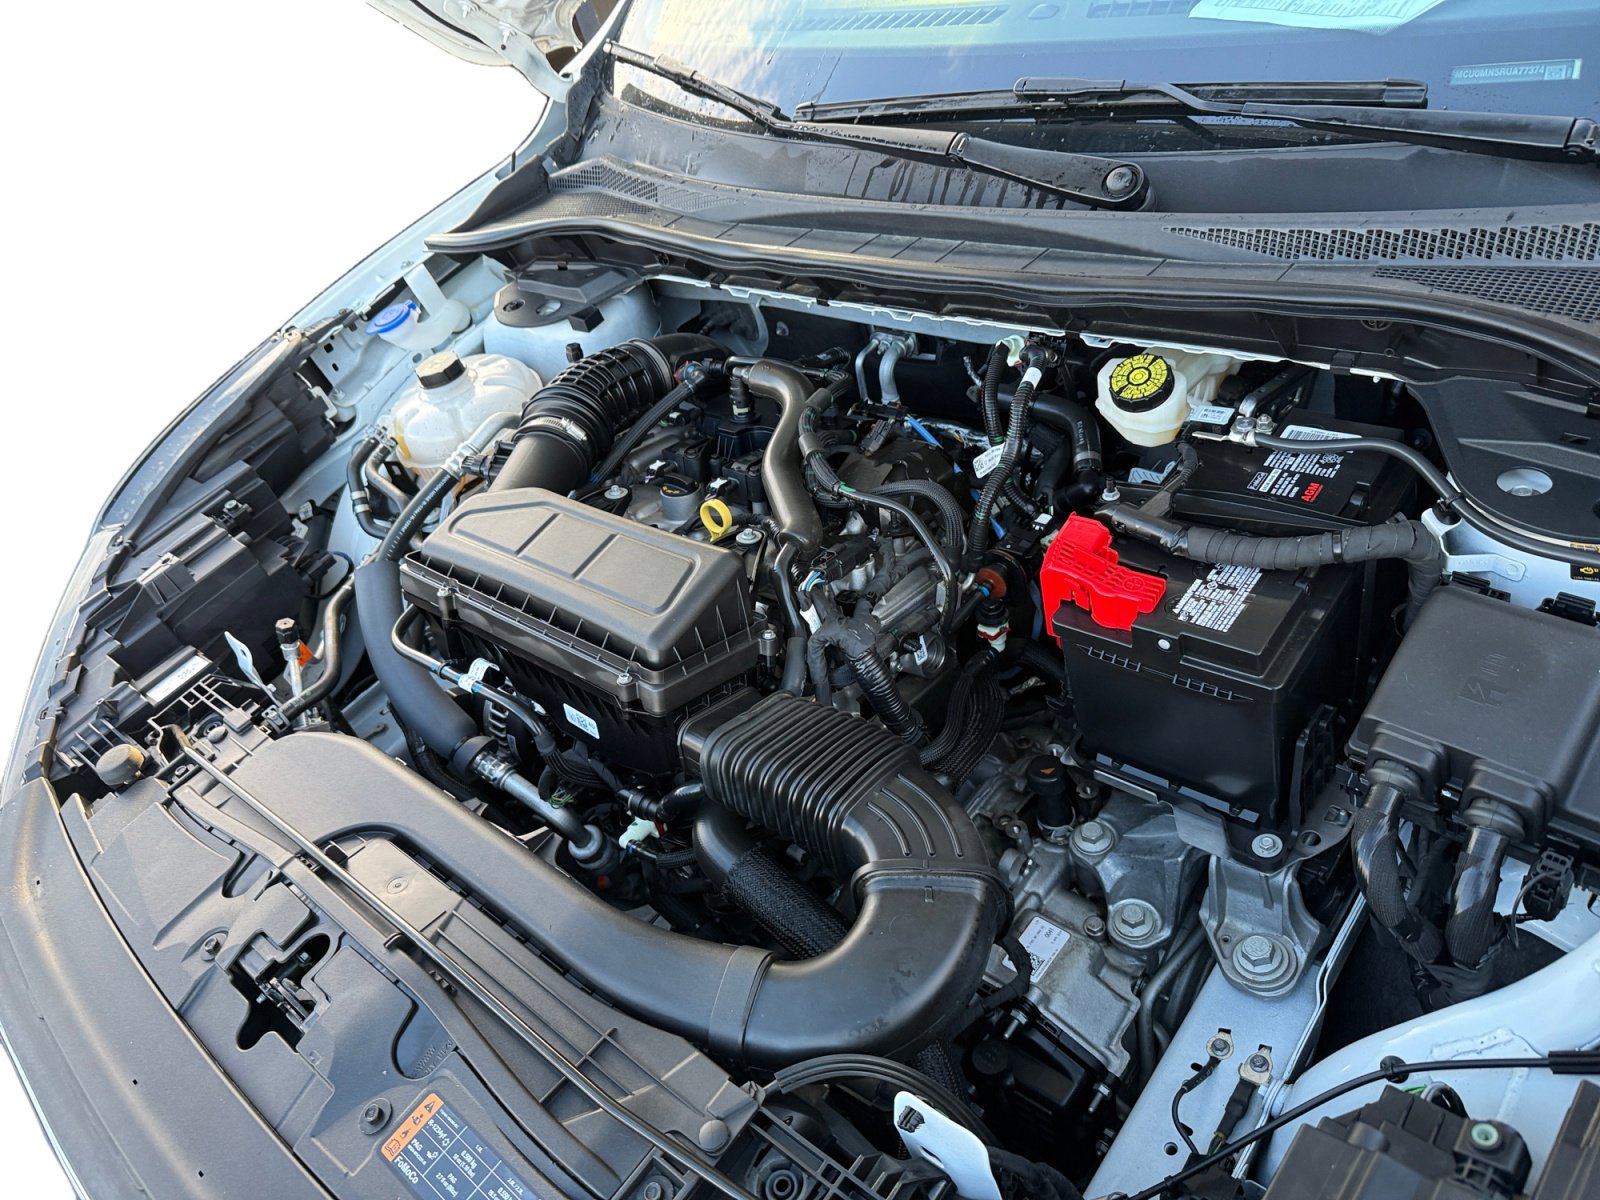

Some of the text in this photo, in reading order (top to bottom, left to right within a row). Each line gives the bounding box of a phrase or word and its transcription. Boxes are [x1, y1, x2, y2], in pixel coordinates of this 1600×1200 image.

[1302, 482, 1319, 502] AGM
[410, 1138, 422, 1151] PAG
[394, 1155, 419, 1183] FoMoCo
